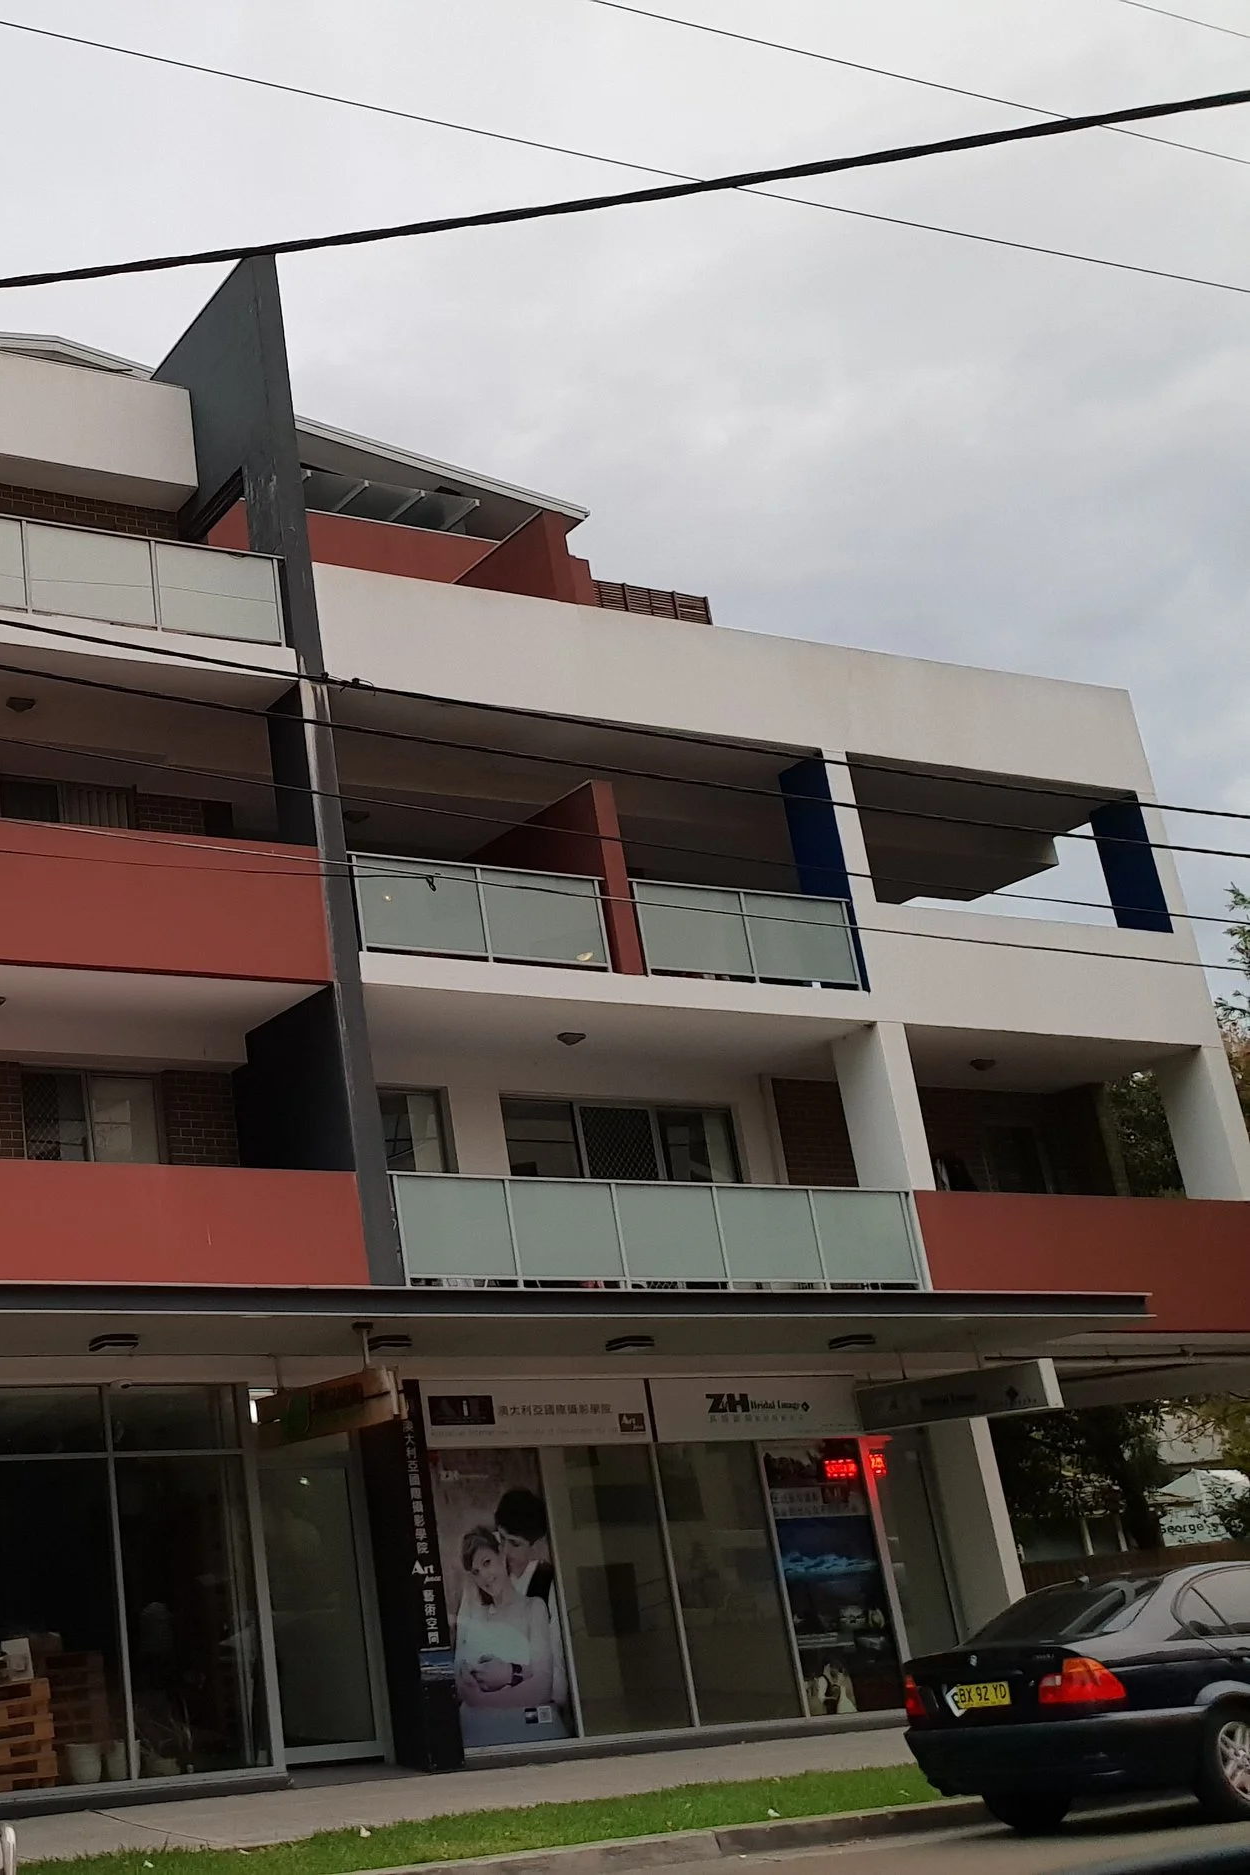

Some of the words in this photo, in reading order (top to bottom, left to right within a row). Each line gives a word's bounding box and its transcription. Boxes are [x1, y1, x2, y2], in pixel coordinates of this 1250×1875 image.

[411, 1560, 435, 1576] Art
[958, 1687, 974, 1703] BX
[975, 1686, 990, 1702] 92
[992, 1683, 1007, 1700] YD
